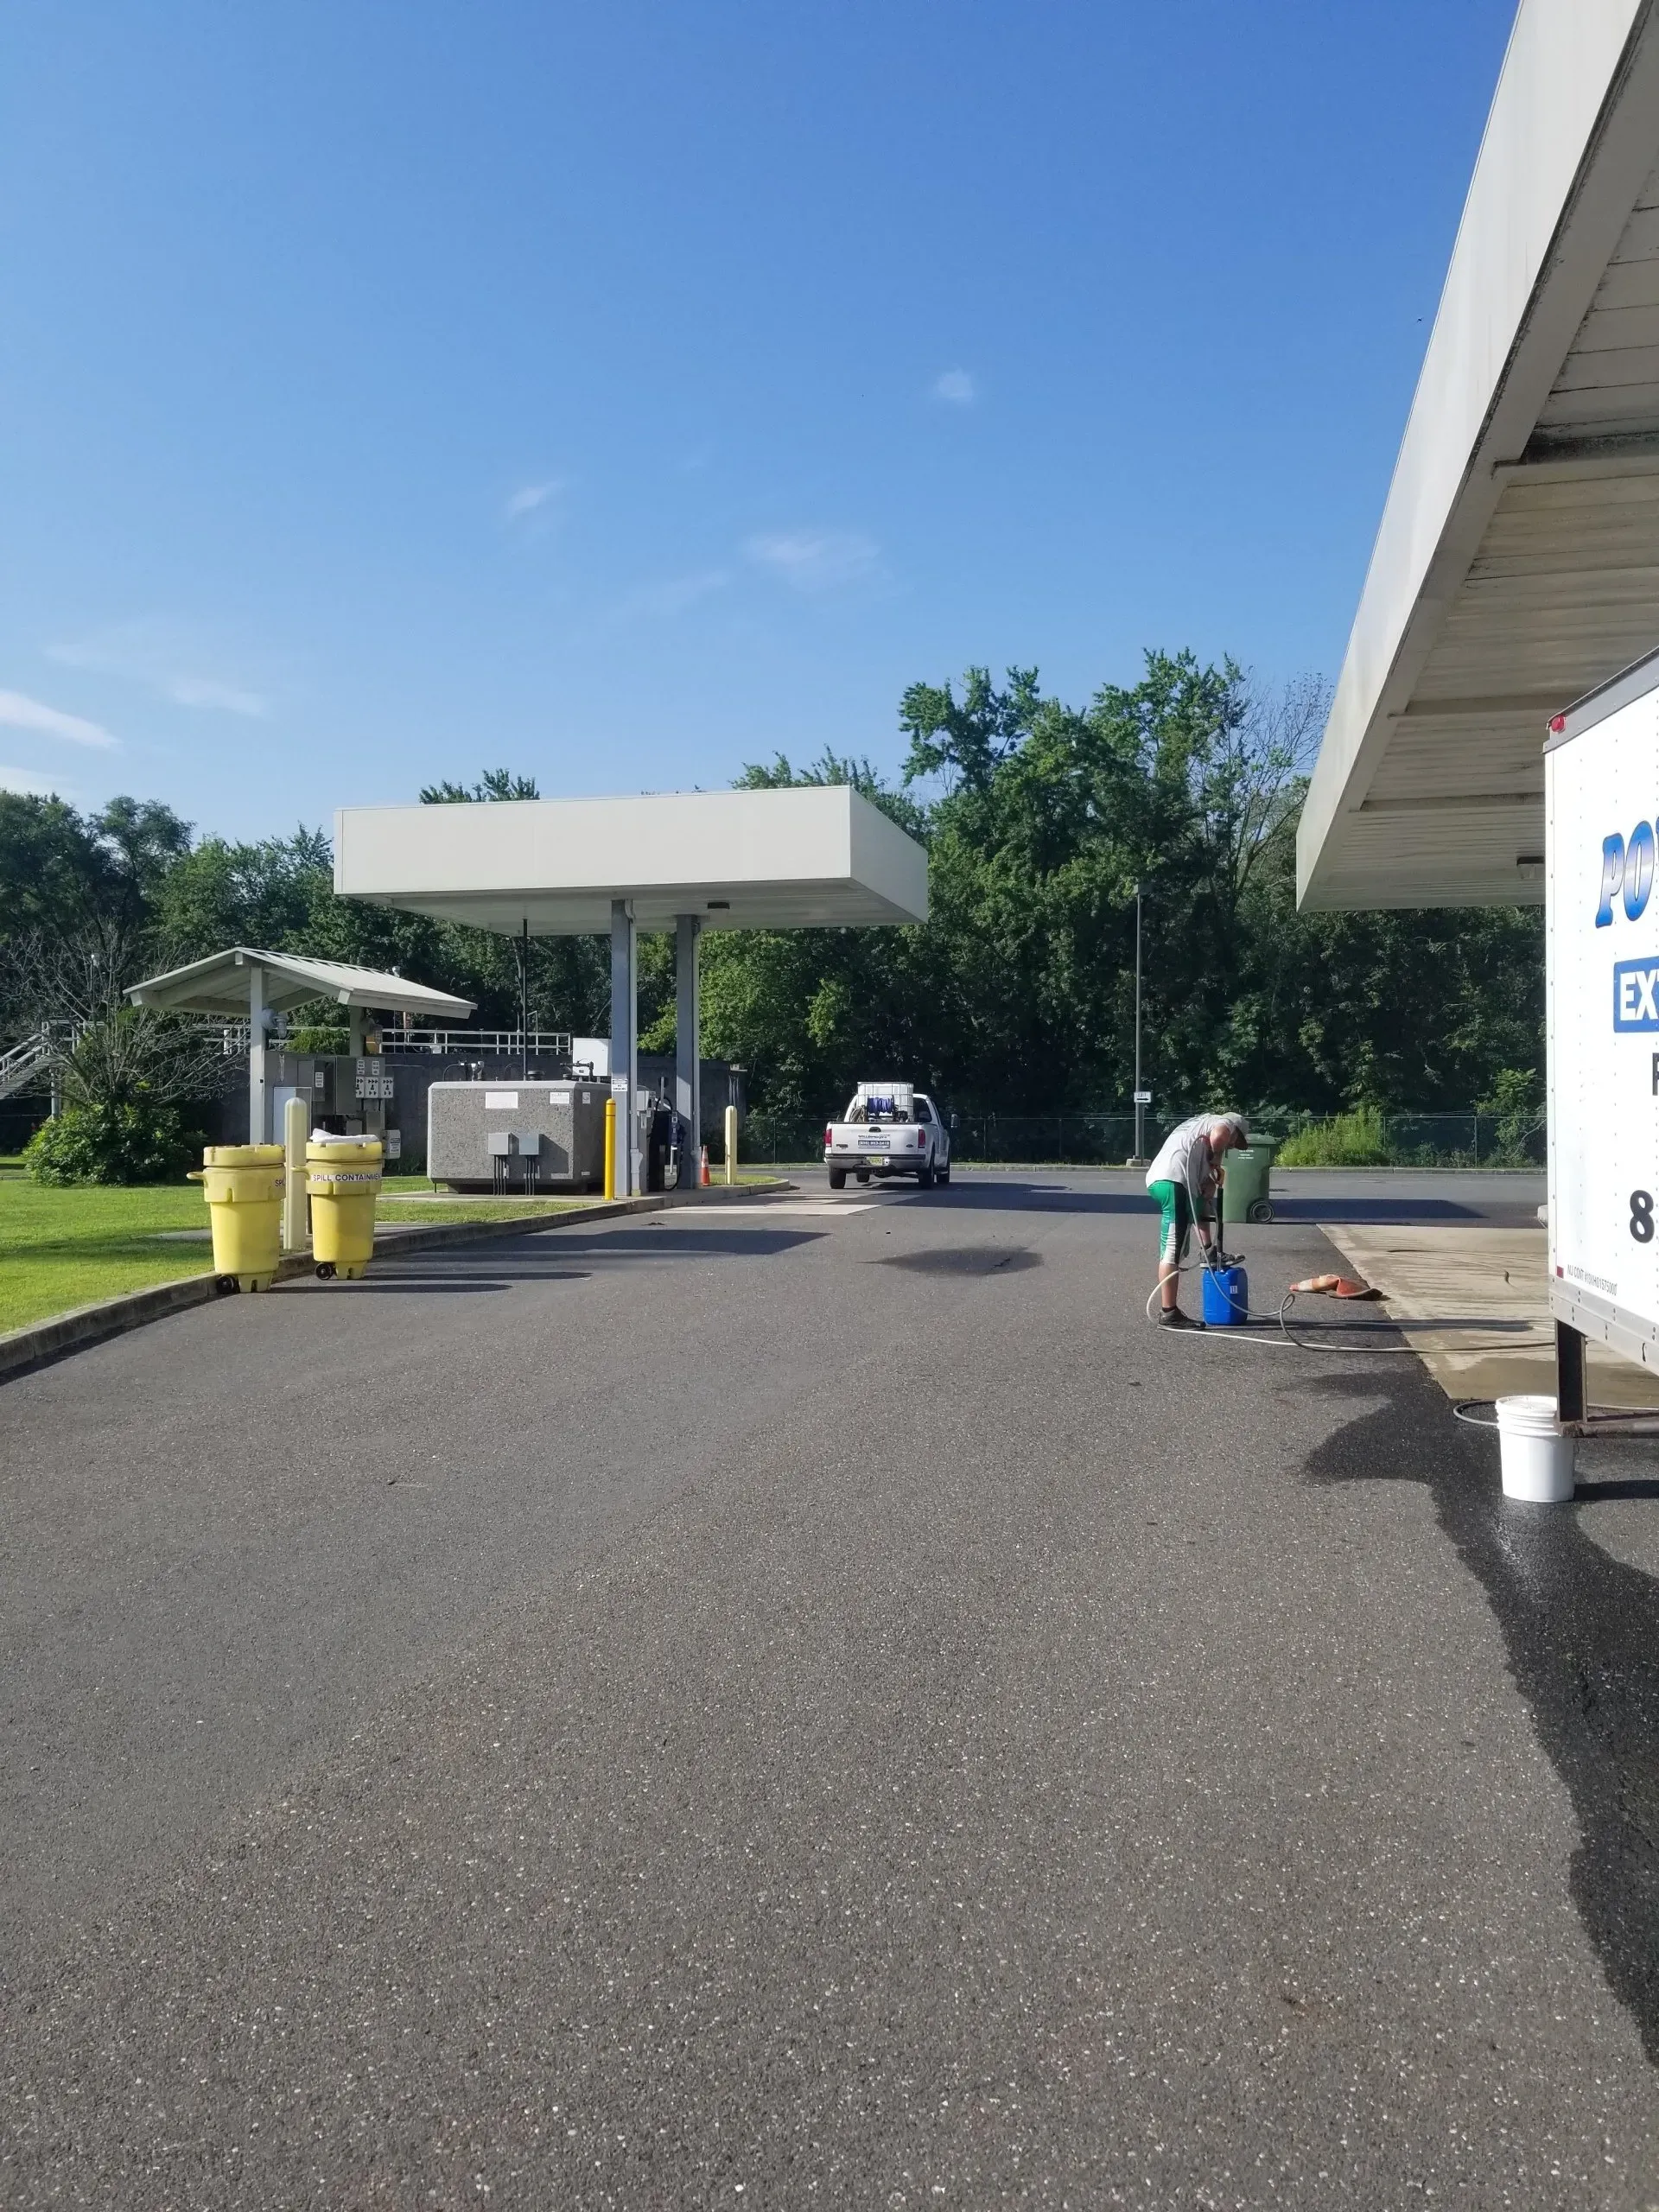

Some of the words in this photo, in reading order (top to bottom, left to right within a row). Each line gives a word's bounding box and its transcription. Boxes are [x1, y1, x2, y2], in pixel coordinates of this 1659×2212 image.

[1595, 817, 1659, 929] PO
[1620, 969, 1659, 1020] EX
[1630, 1189, 1655, 1243] 8
